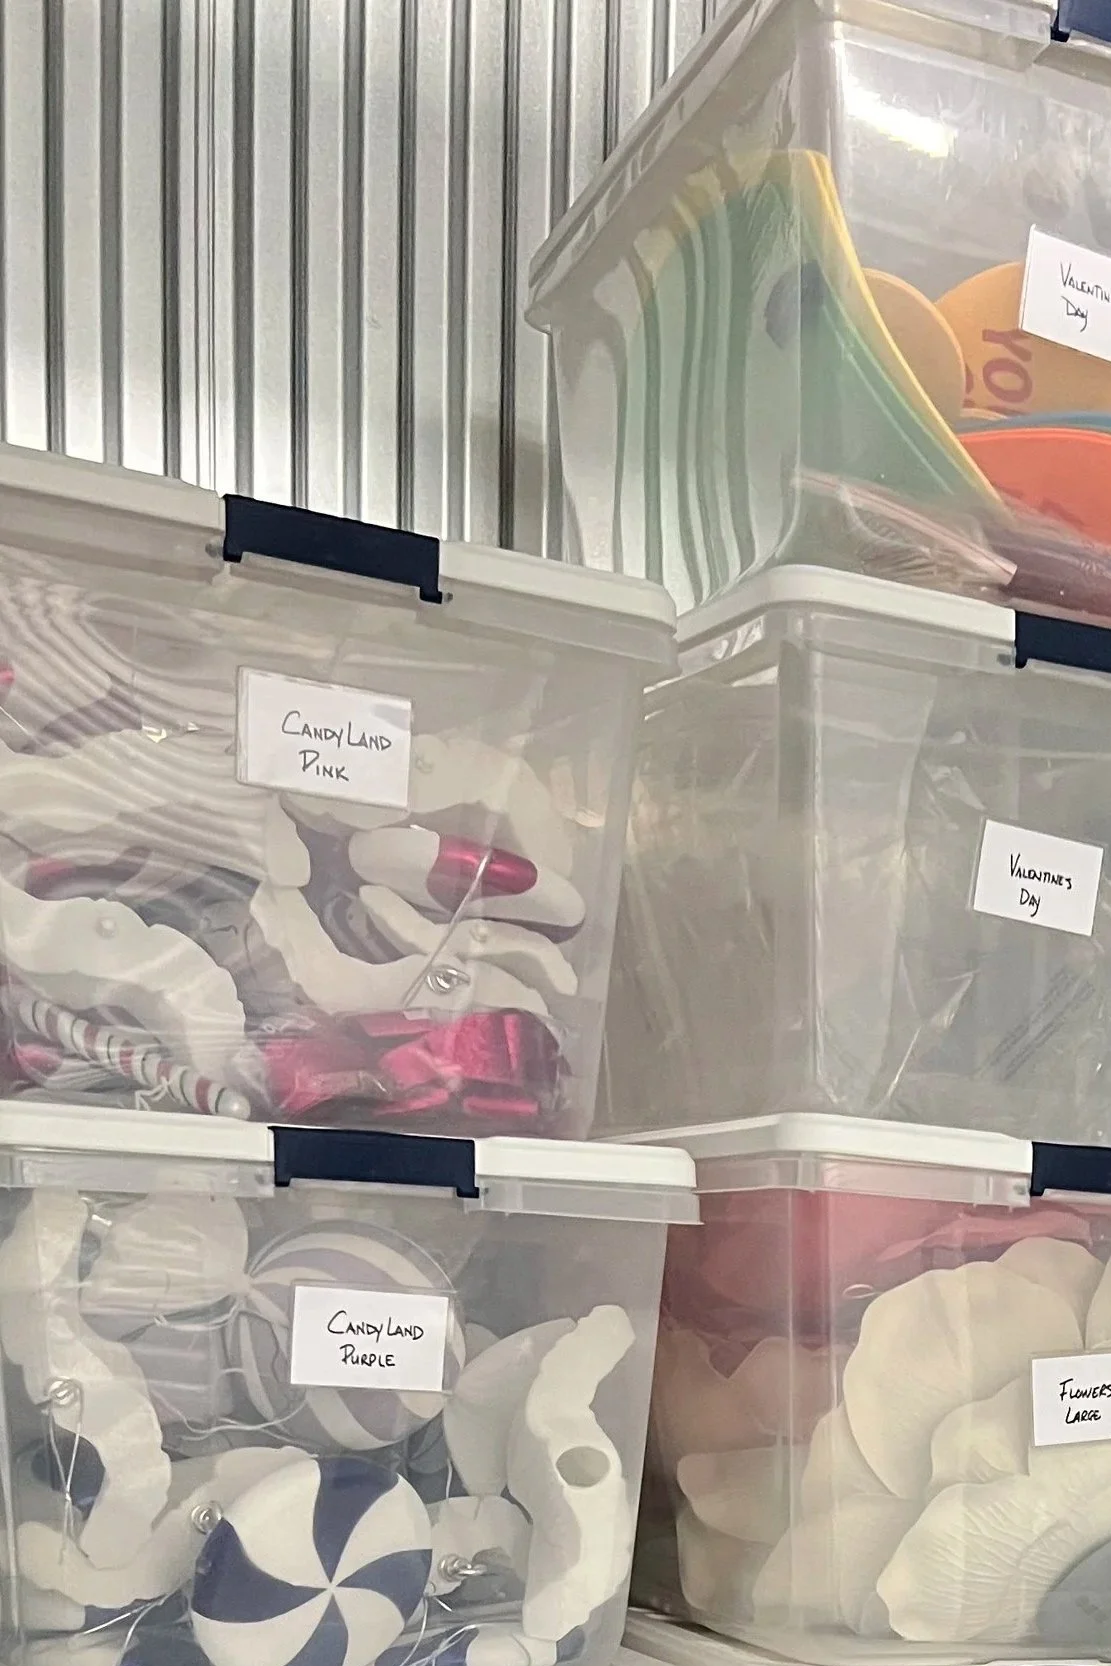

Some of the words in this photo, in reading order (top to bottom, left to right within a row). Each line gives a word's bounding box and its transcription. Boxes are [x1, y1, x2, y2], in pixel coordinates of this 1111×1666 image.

[982, 328, 1033, 416] YO
[300, 750, 349, 781] PINK
[1019, 888, 1041, 916] DAY
[341, 1345, 396, 1368] PURPLE
[1065, 1408, 1101, 1422] LARGE
